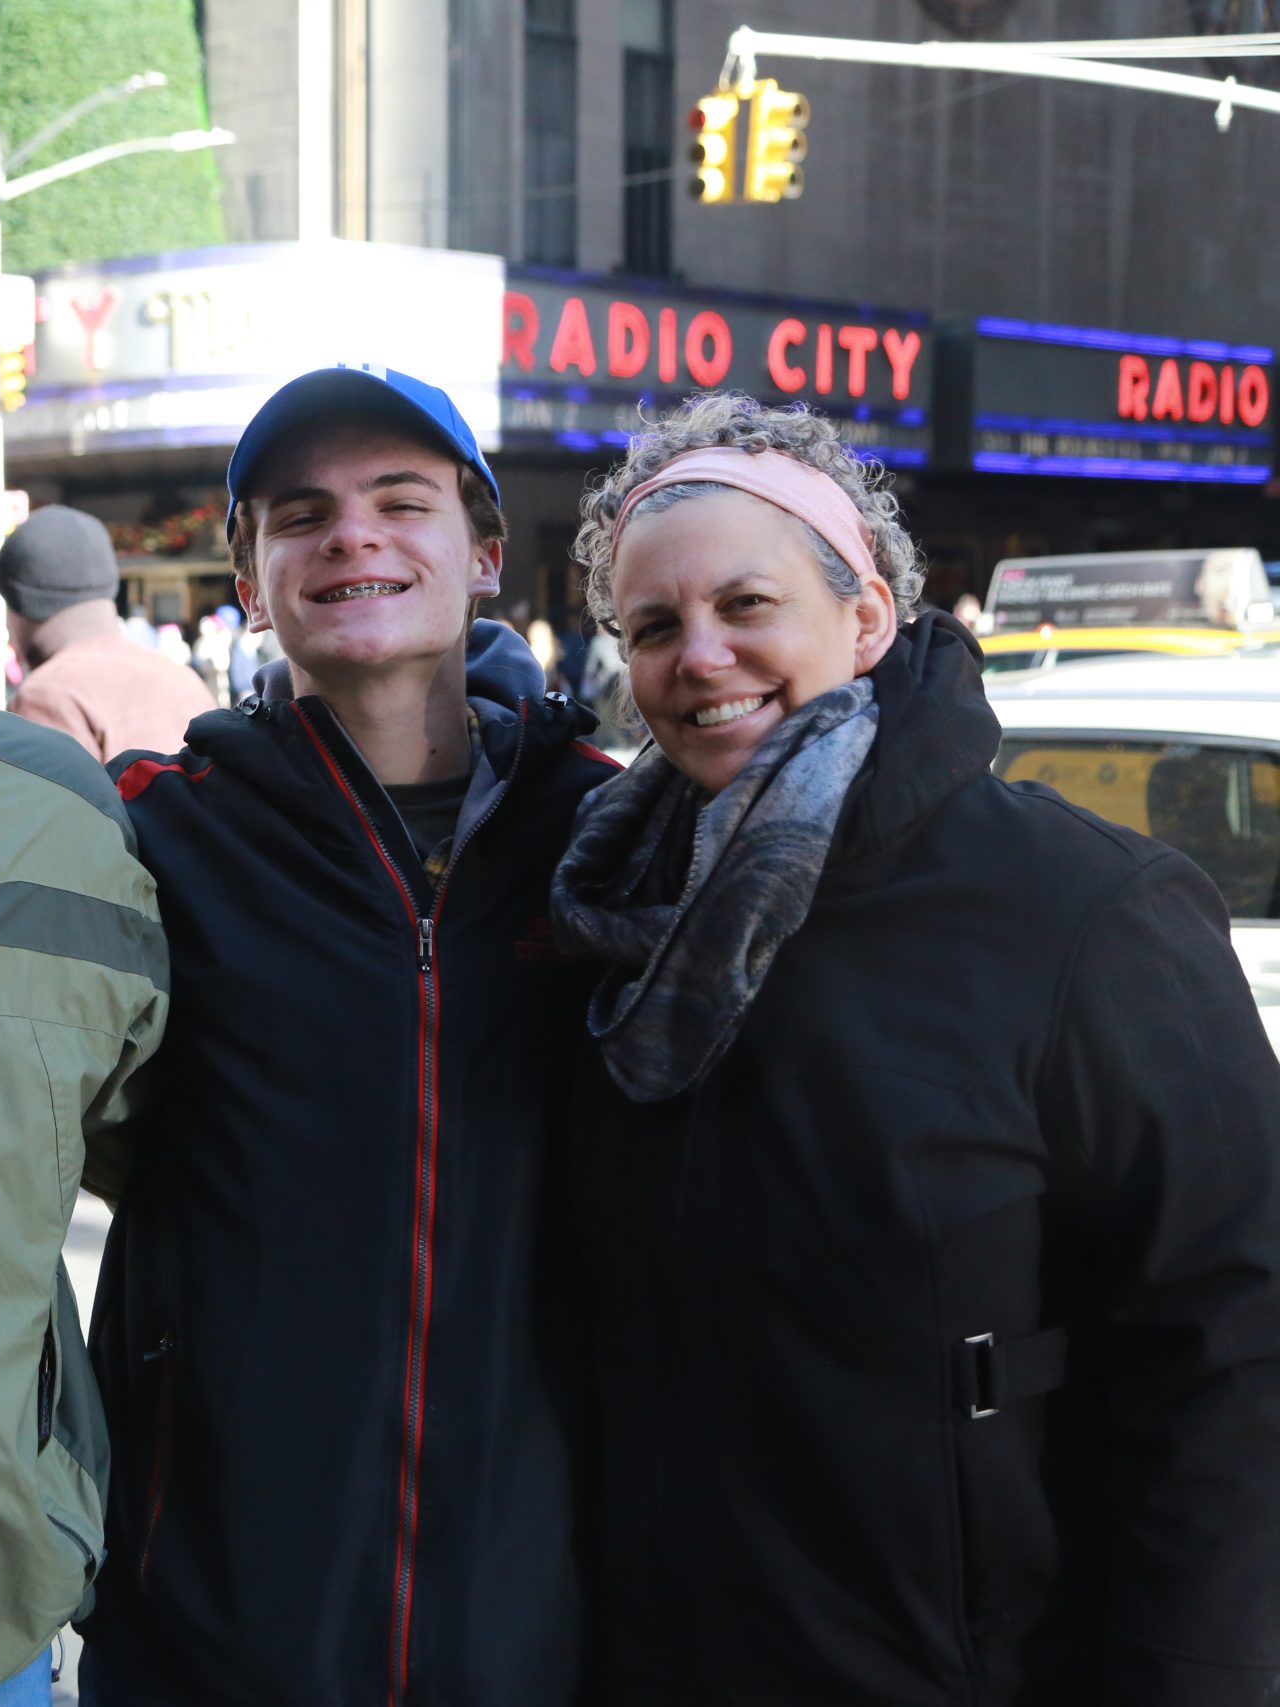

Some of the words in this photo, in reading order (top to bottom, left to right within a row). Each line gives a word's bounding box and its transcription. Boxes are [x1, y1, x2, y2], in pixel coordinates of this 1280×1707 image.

[501, 291, 733, 387] RADIO
[768, 318, 921, 400] CITY
[1118, 354, 1269, 427] RADIO
